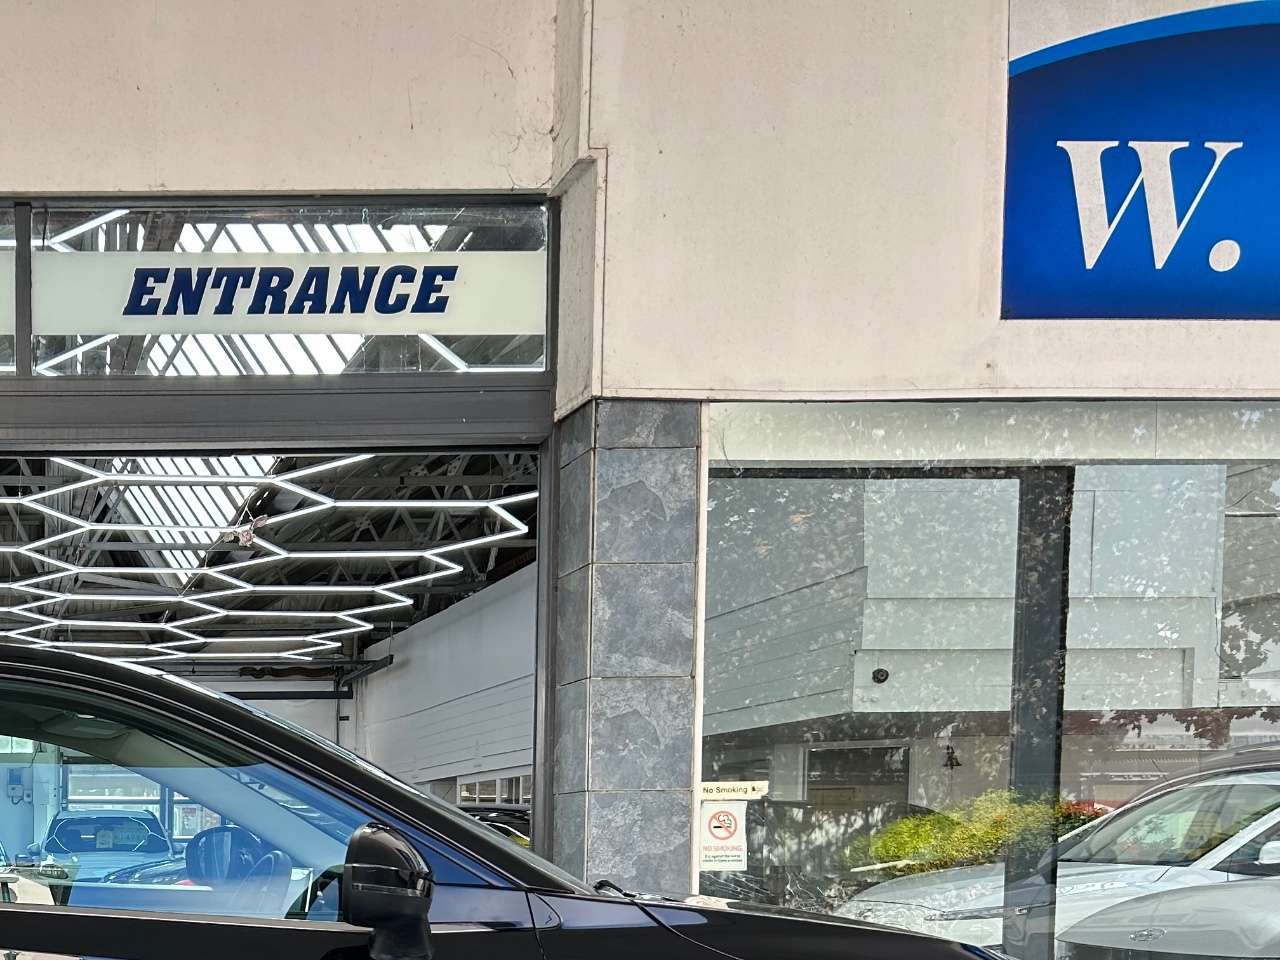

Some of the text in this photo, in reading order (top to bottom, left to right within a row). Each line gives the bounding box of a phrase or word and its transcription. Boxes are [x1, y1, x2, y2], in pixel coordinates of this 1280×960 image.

[1056, 140, 1243, 272] W.
[122, 265, 458, 316] ENTRANCE
[716, 786, 748, 795] Smoking
